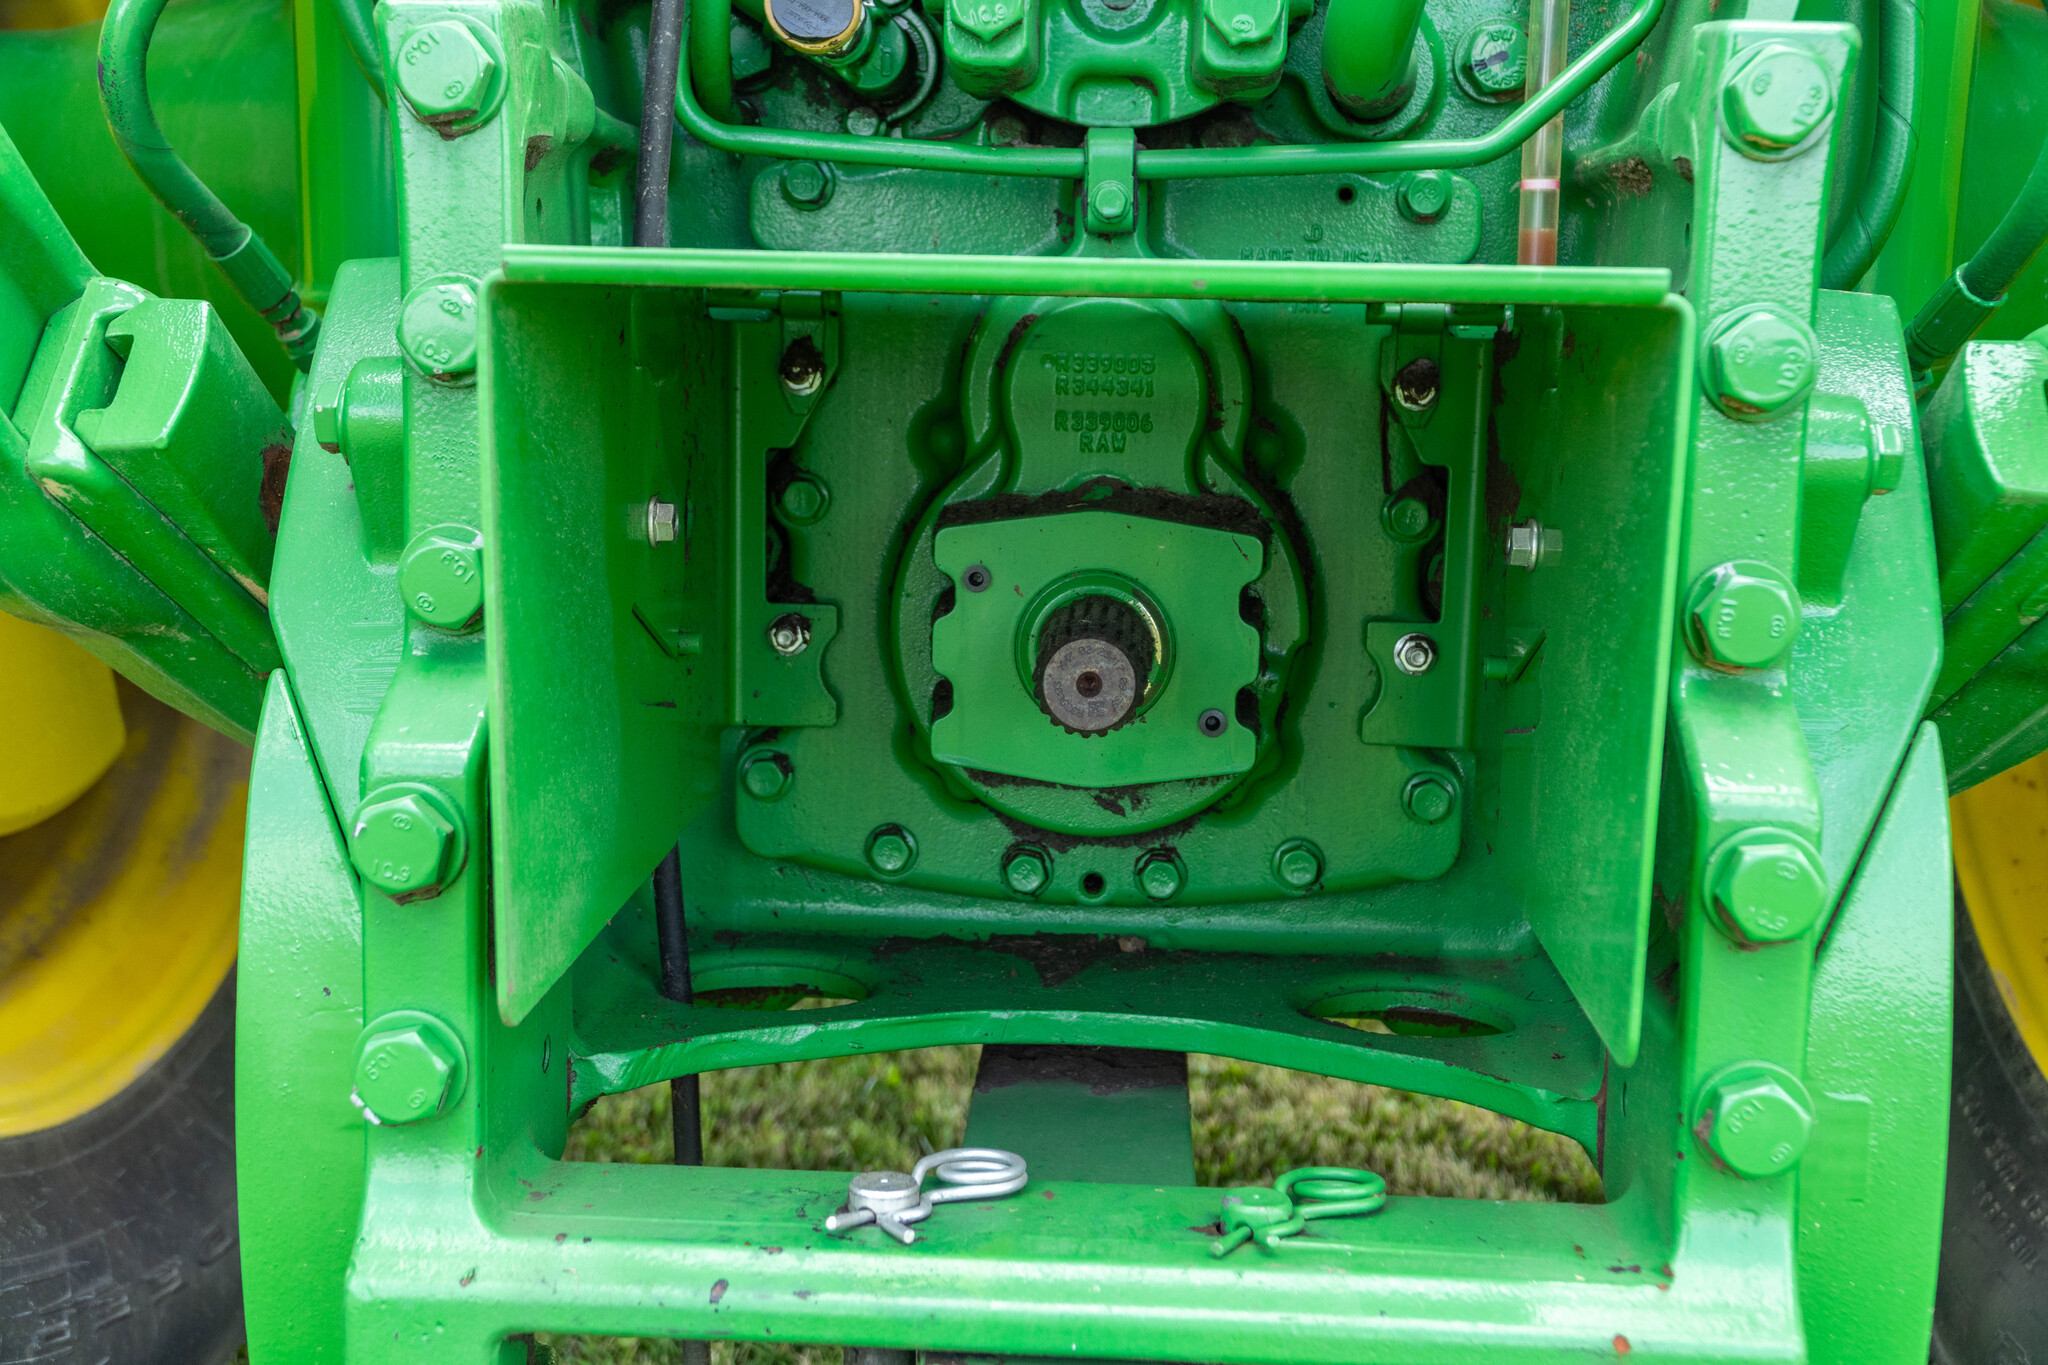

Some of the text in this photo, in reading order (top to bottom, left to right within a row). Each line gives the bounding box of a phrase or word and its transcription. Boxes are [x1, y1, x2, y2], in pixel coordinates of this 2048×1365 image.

[969, 3, 1007, 26] 10.9
[405, 31, 440, 66] 10.9
[1055, 375, 1155, 398] R344341
[1054, 409, 1154, 434] R339006
[1079, 431, 1127, 453] RAW
